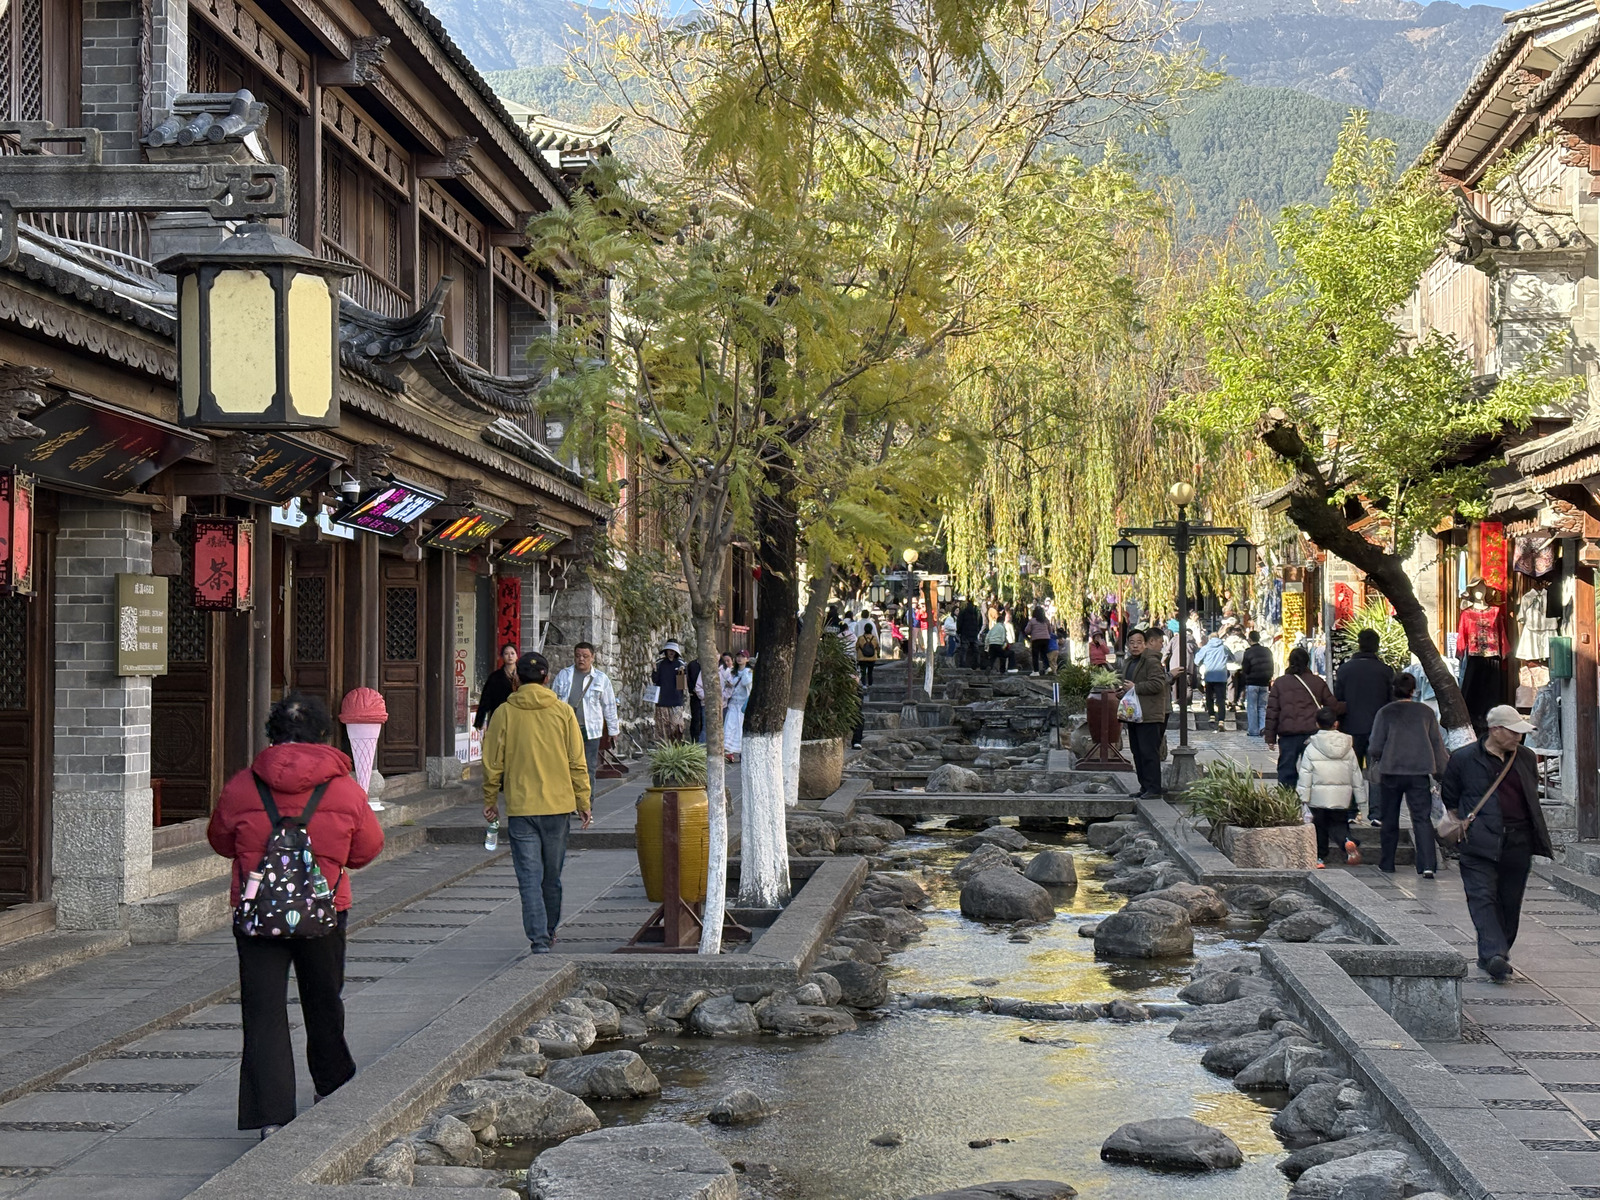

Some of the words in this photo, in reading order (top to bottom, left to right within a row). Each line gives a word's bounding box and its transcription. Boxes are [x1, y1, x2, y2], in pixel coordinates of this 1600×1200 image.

[383, 493, 435, 523] 冰淇淋
[198, 557, 233, 591] 茶
